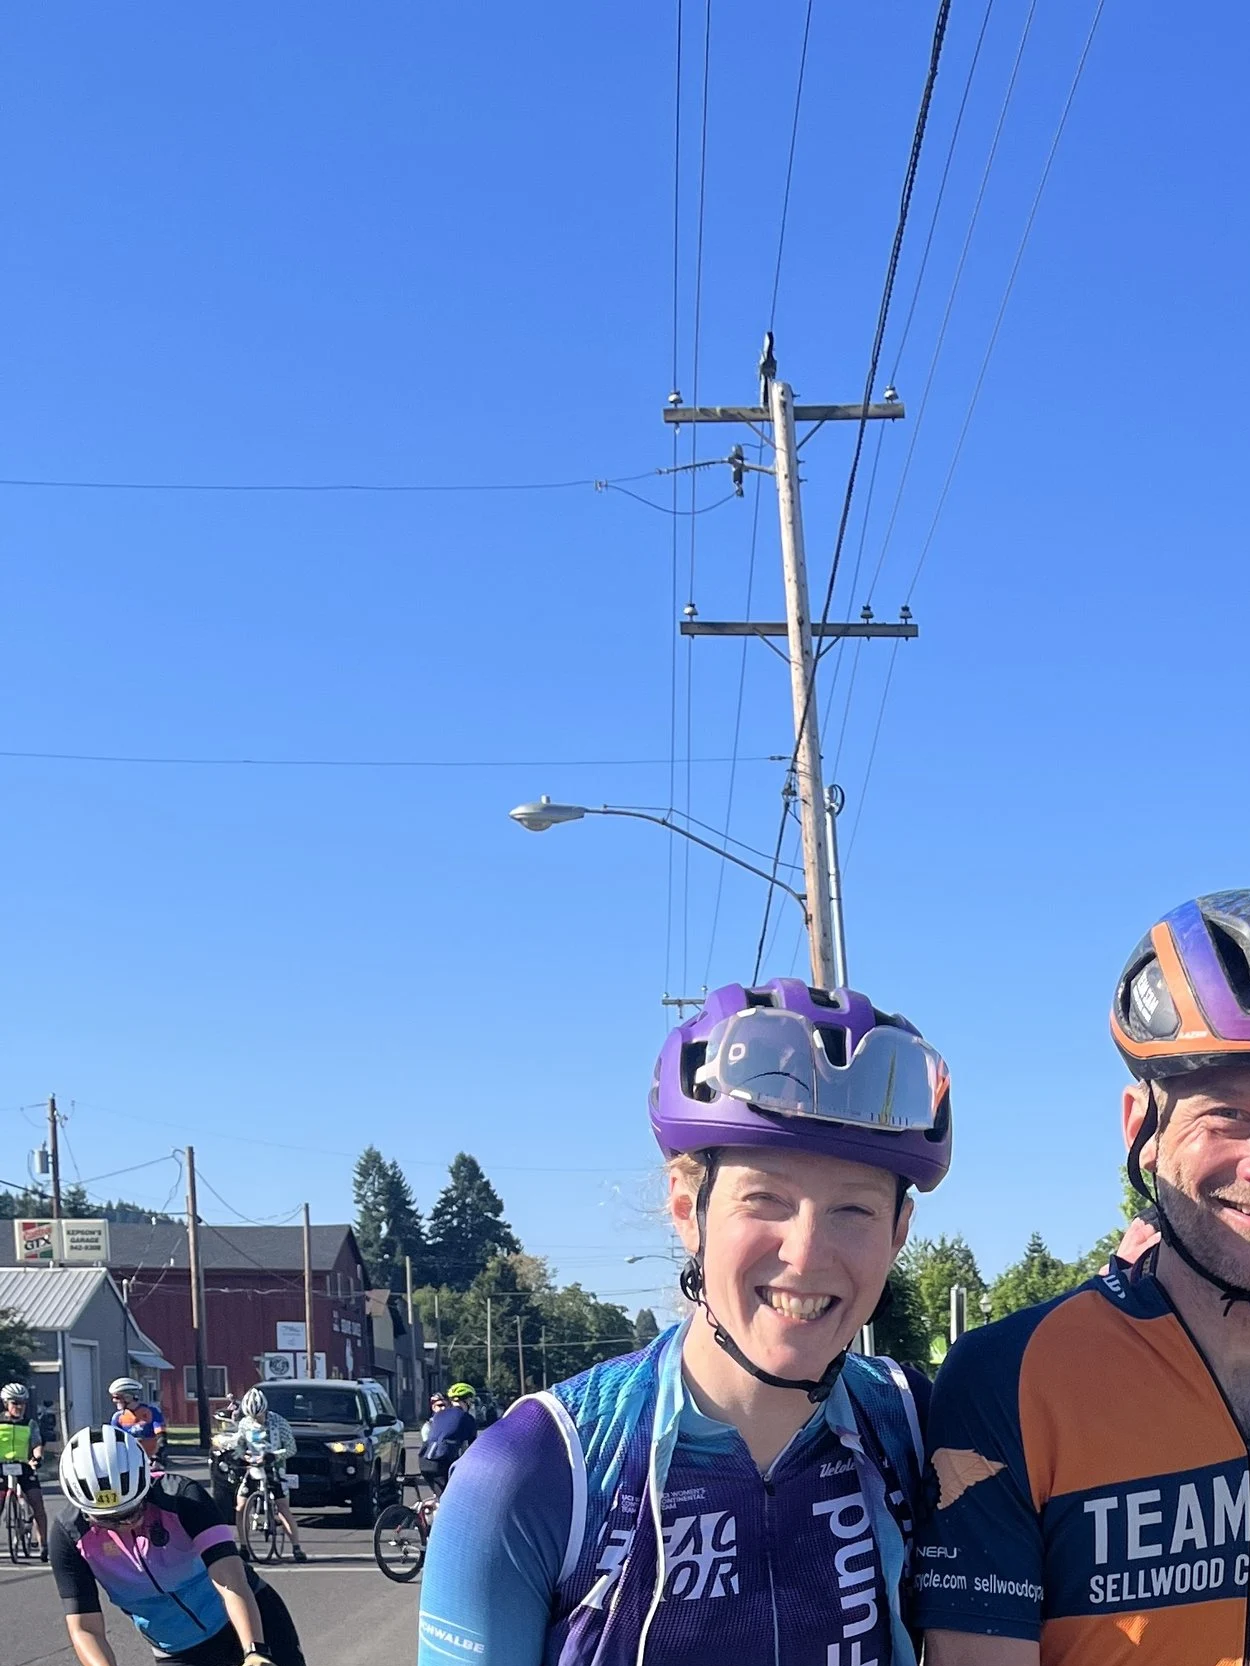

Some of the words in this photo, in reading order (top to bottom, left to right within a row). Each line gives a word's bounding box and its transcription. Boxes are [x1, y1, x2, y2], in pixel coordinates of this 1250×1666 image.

[24, 1237, 51, 1251] GTX
[97, 1493, 118, 1503] 417
[1089, 1556, 1225, 1604] SELLWOOD
